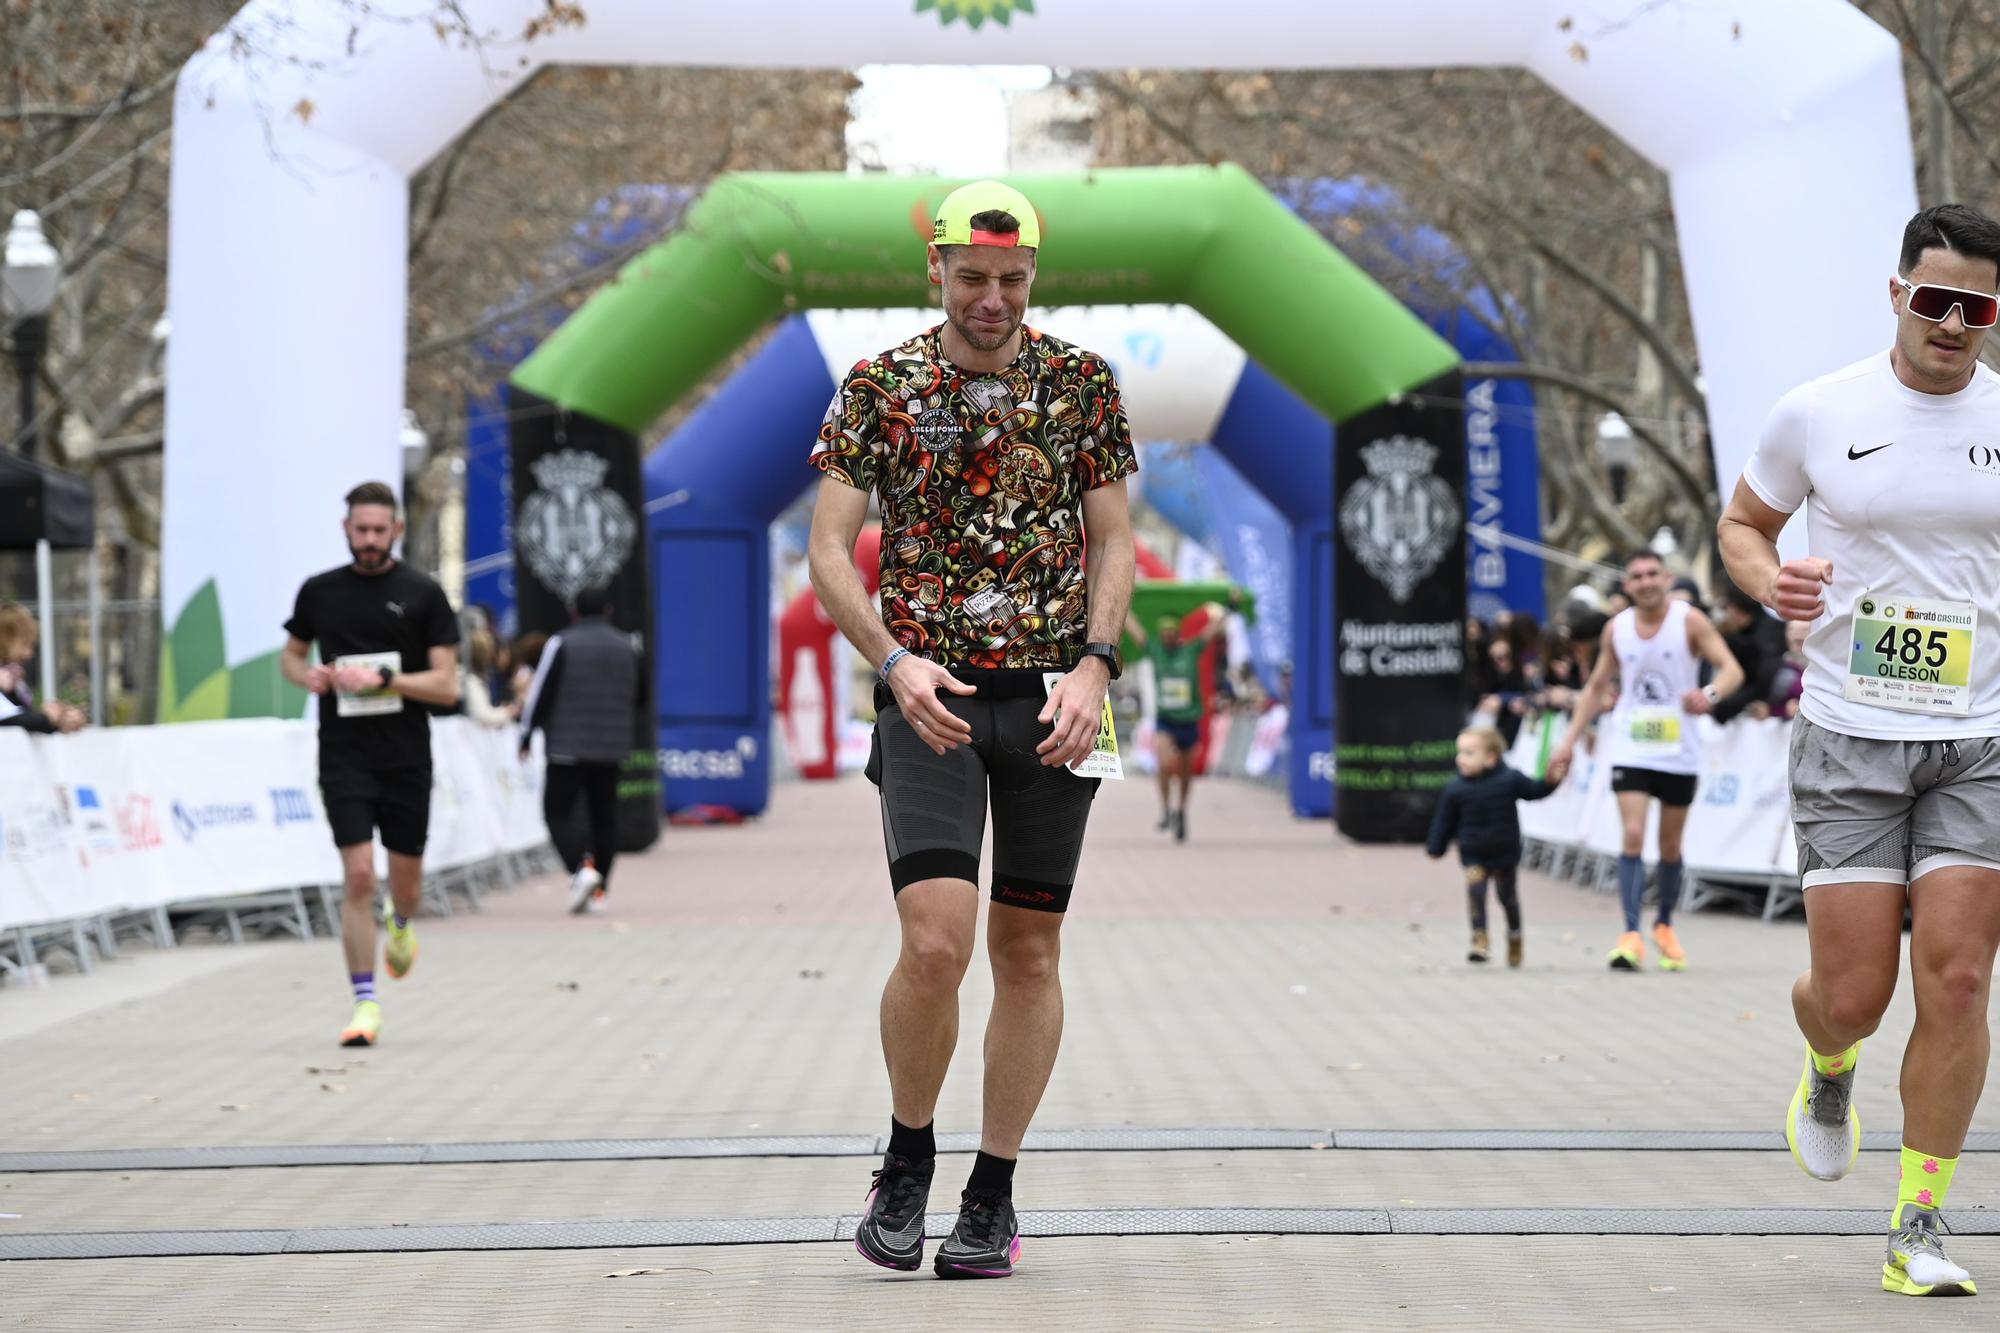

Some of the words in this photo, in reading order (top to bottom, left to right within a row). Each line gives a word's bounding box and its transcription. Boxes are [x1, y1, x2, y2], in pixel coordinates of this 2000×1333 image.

[1467, 379, 1505, 588] BAVIERA
[974, 594, 995, 610] PIZZA
[1875, 625, 1948, 668] 485
[1878, 663, 1940, 683] OLESON
